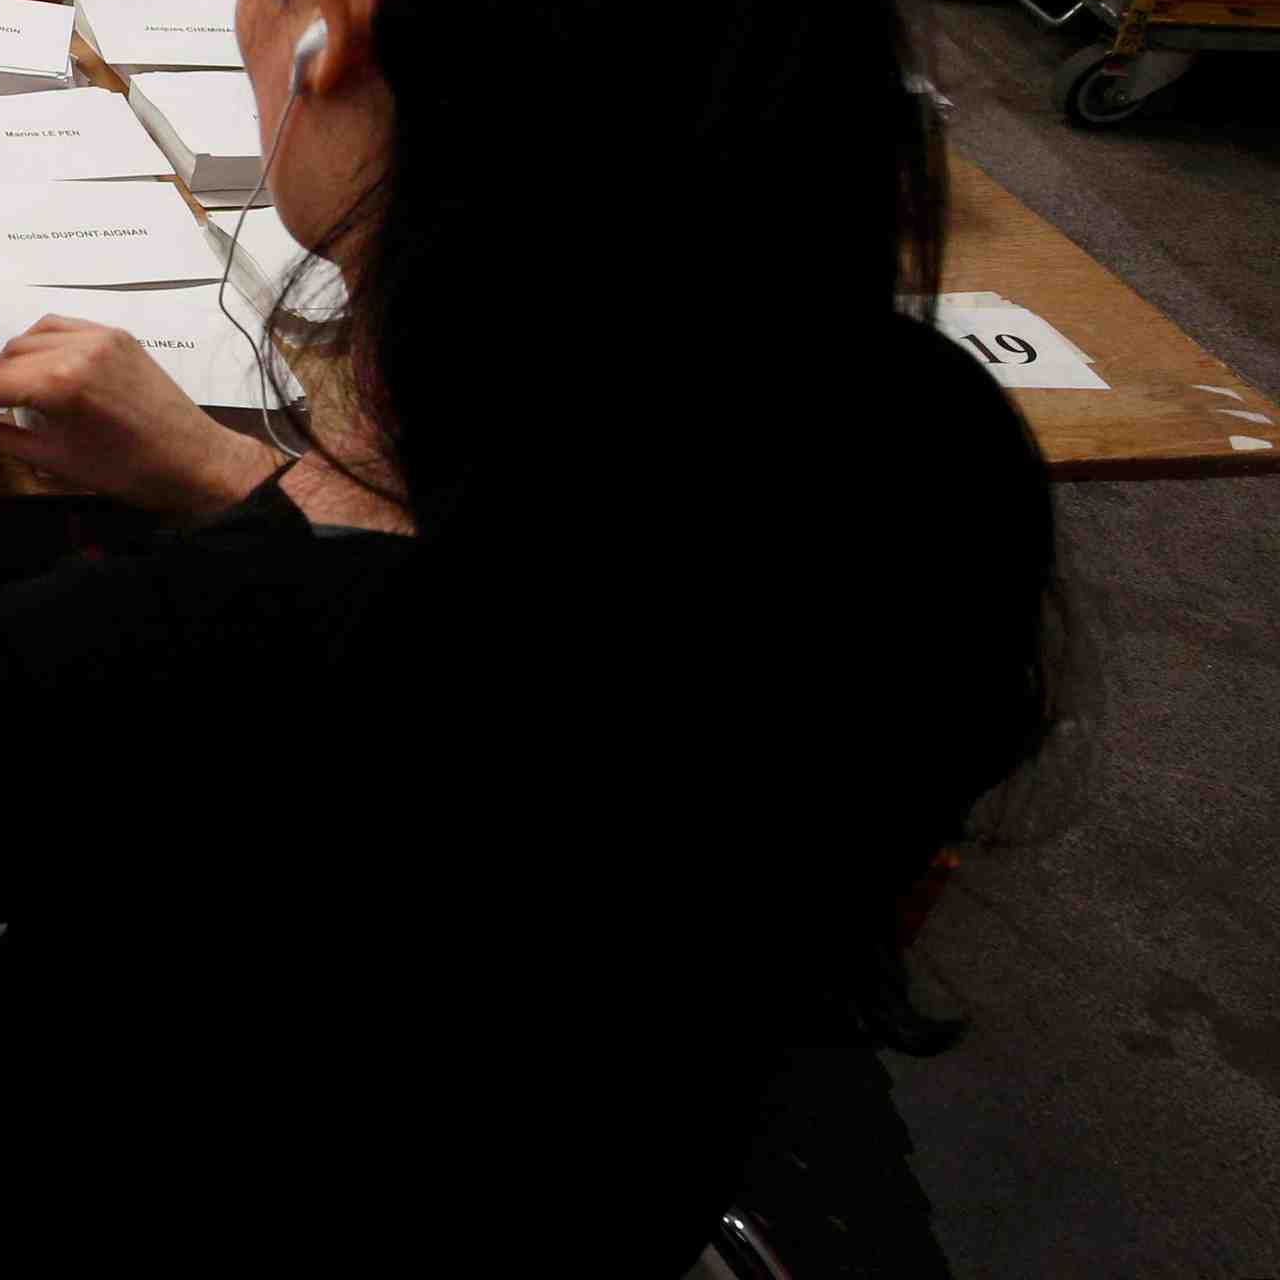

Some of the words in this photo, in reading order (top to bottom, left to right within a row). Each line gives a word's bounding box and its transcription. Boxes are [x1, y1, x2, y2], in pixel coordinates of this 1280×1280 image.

[185, 25, 234, 33] CHEMINA
[7, 232, 49, 241] Nicolas
[50, 227, 148, 240] DUPONT-AIGNAN
[136, 338, 196, 349] ELINEAU
[959, 332, 1038, 365] 19
